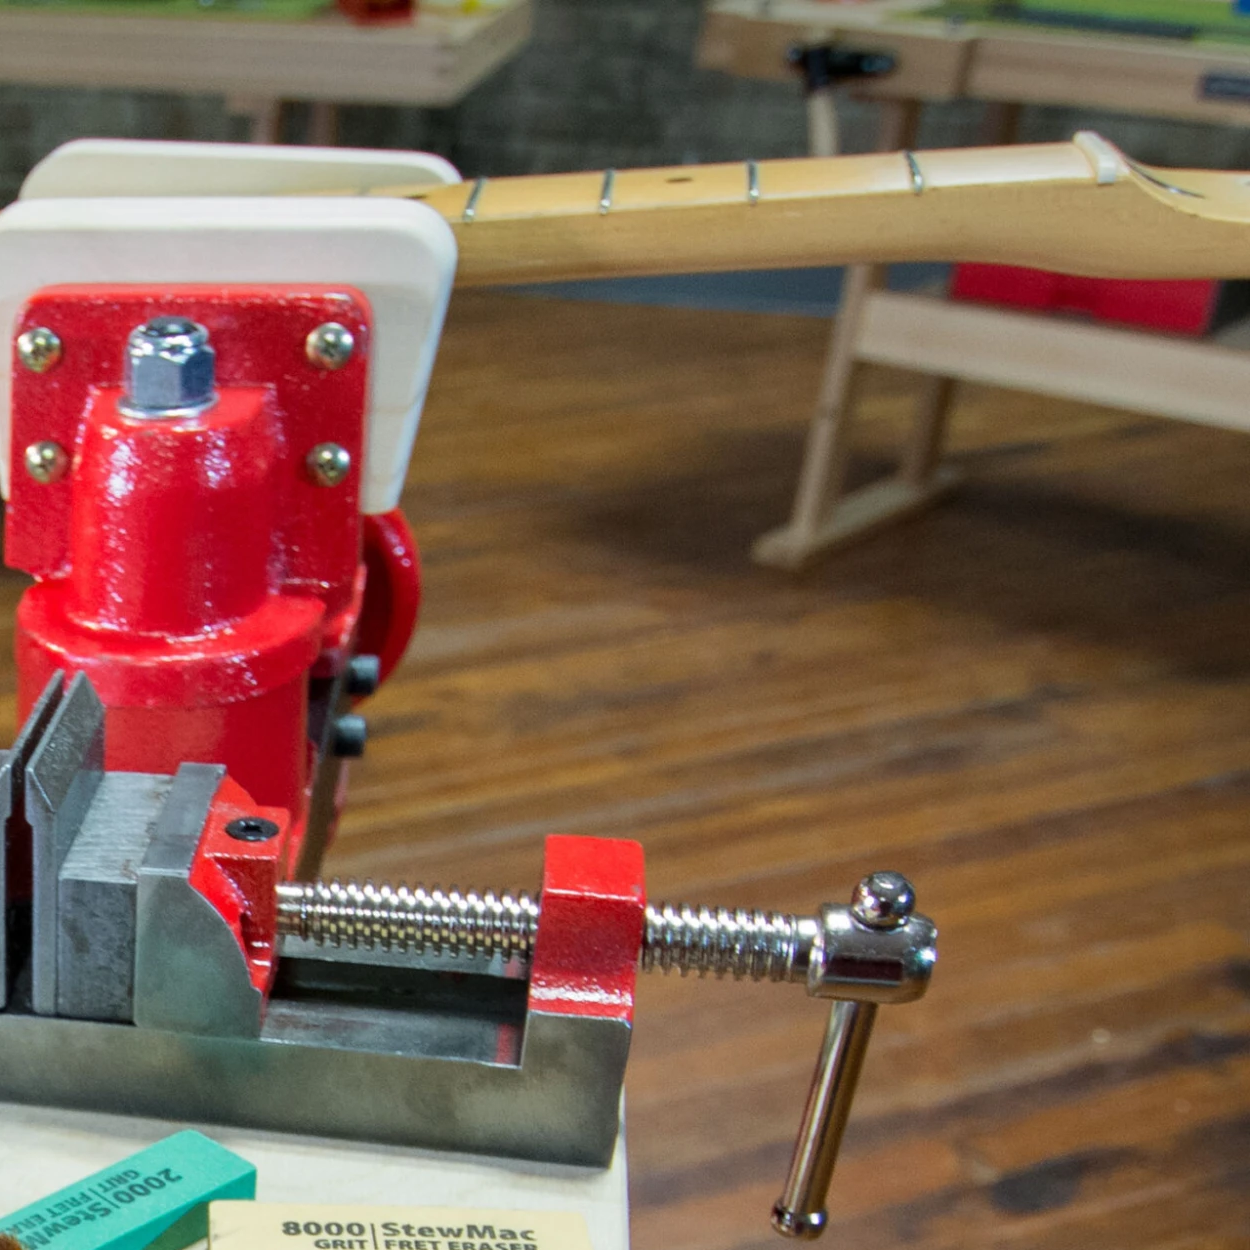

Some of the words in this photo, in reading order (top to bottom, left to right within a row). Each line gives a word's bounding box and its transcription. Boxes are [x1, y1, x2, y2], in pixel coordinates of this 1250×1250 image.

[97, 1169, 140, 1193] GRIT
[112, 1167, 183, 1204] 2000
[46, 1191, 94, 1218] FRET
[6, 1213, 47, 1236] ERA
[282, 1221, 367, 1237] 8000
[380, 1222, 538, 1241] StewMac
[313, 1239, 368, 1250] GRIT
